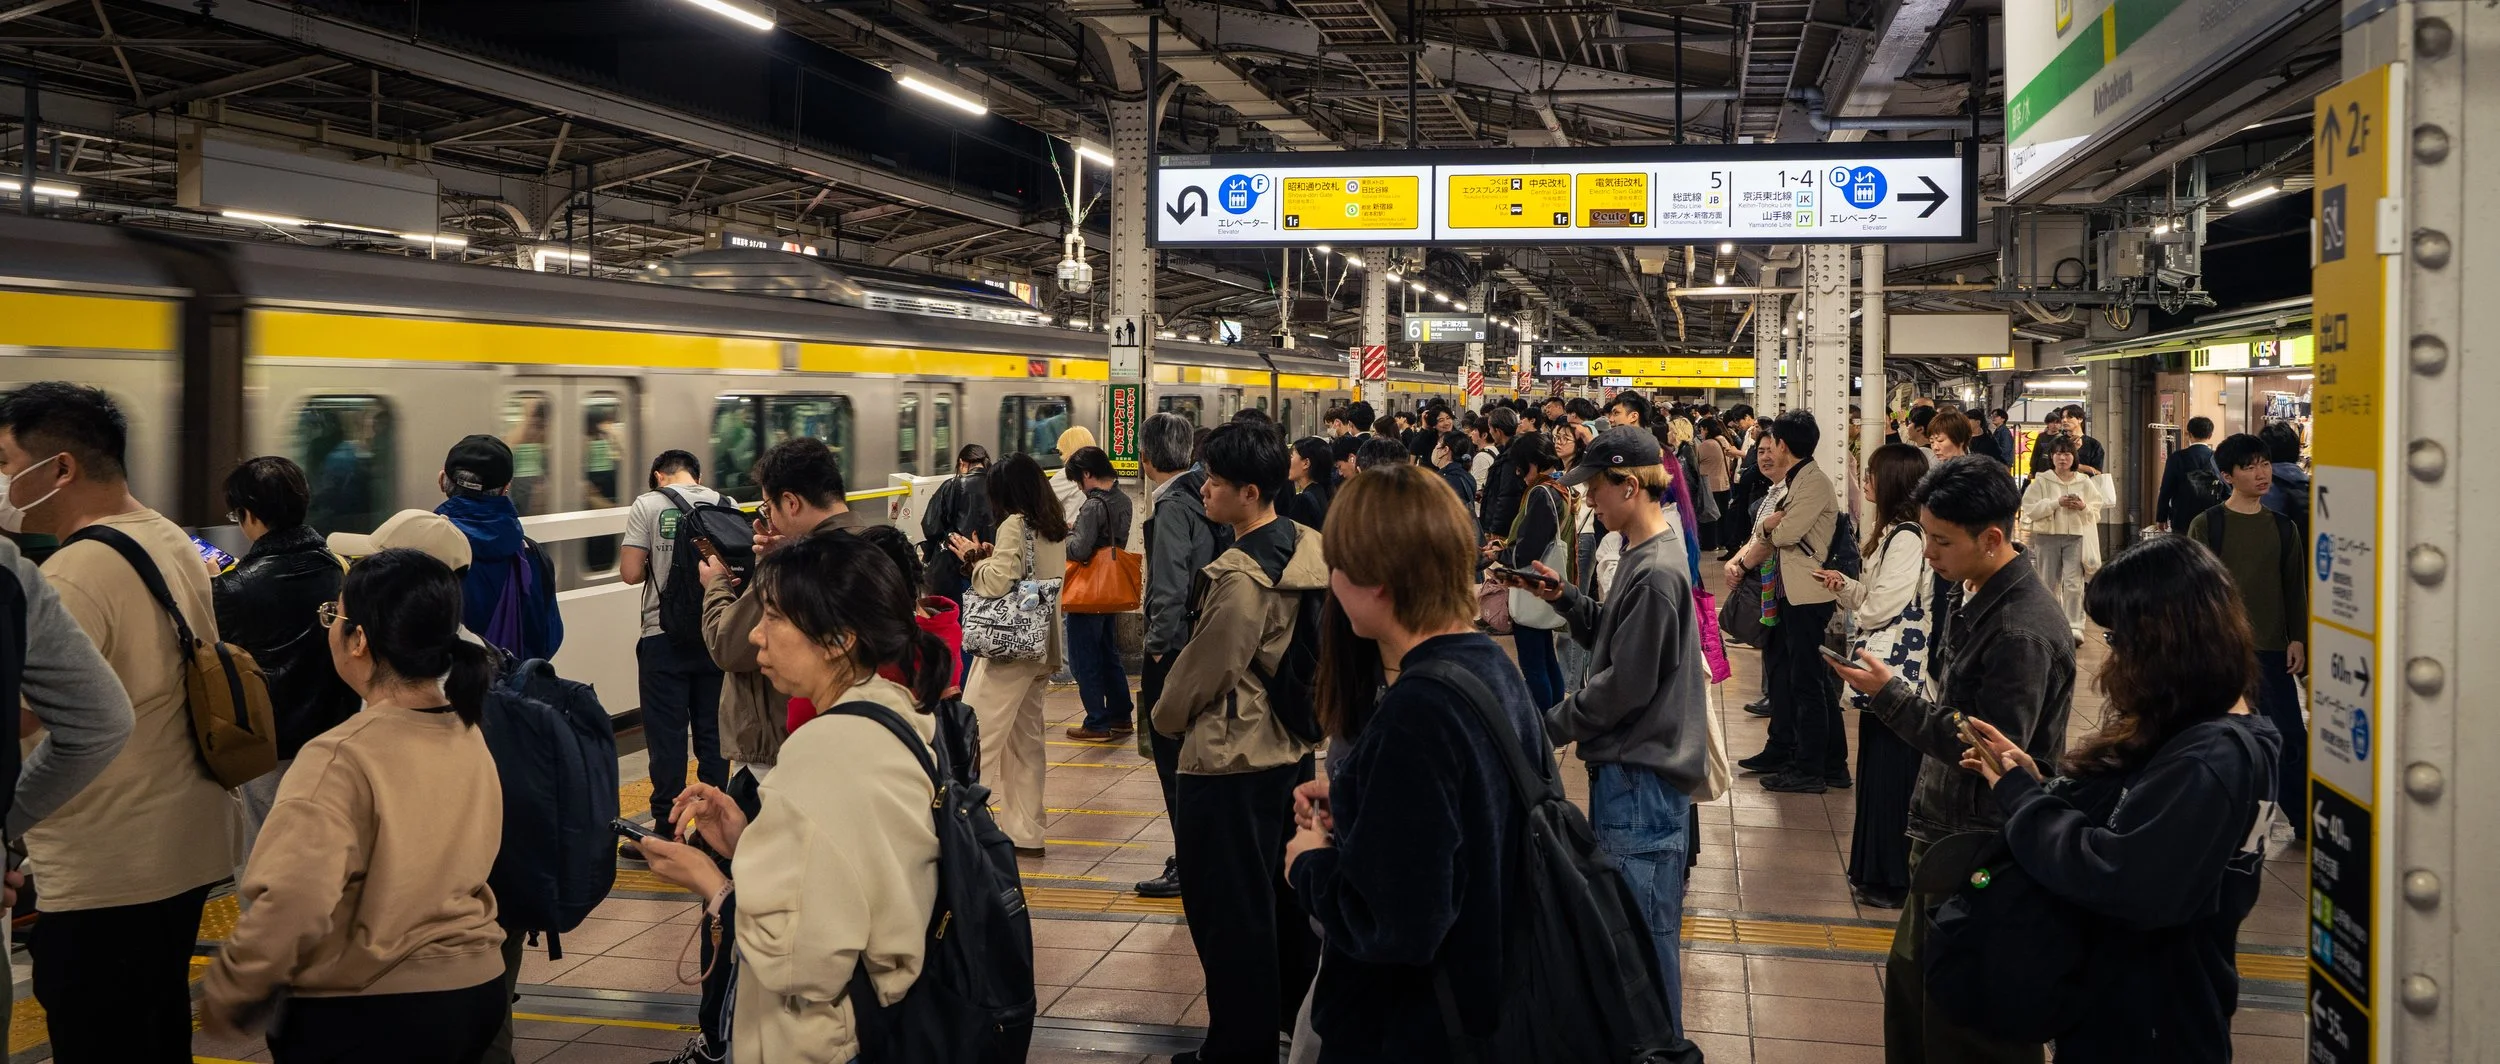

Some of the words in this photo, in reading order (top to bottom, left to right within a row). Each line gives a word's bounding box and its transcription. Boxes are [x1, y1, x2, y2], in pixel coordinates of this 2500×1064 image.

[2093, 65, 2133, 118] Akihabara
[2347, 102, 2370, 157] 2F
[1595, 178, 1643, 187] 電気街改札
[1711, 171, 1722, 189] 5
[1836, 172, 1846, 183] D
[1256, 179, 1263, 189] F
[1288, 182, 1340, 191] 昭和通り改札
[1529, 179, 1567, 188] 中央改札
[1672, 193, 1702, 202] 総武線
[1709, 196, 1720, 204] JB
[1743, 191, 1792, 201] 京浜東北線
[1800, 195, 1810, 203] JK
[1555, 214, 1567, 224] 1F
[1592, 212, 1627, 221] ecute
[1632, 213, 1643, 223] 1F
[1663, 211, 1722, 219] 御茶ノ水・新宿方面
[1762, 211, 1792, 220] 山手線
[1799, 215, 1810, 223] JY
[1829, 214, 1887, 223] エレベーター
[1218, 219, 1269, 227] エレベーター
[1287, 216, 1299, 226] 1F
[1409, 321, 1421, 338] 6
[2319, 313, 2348, 353] 出口
[2252, 341, 2277, 357] KIOSK
[1114, 389, 1125, 455] ヨドバシカメラ
[2331, 652, 2352, 686] 60m
[2328, 814, 2352, 852] 40m
[2327, 1006, 2349, 1049] 55m
